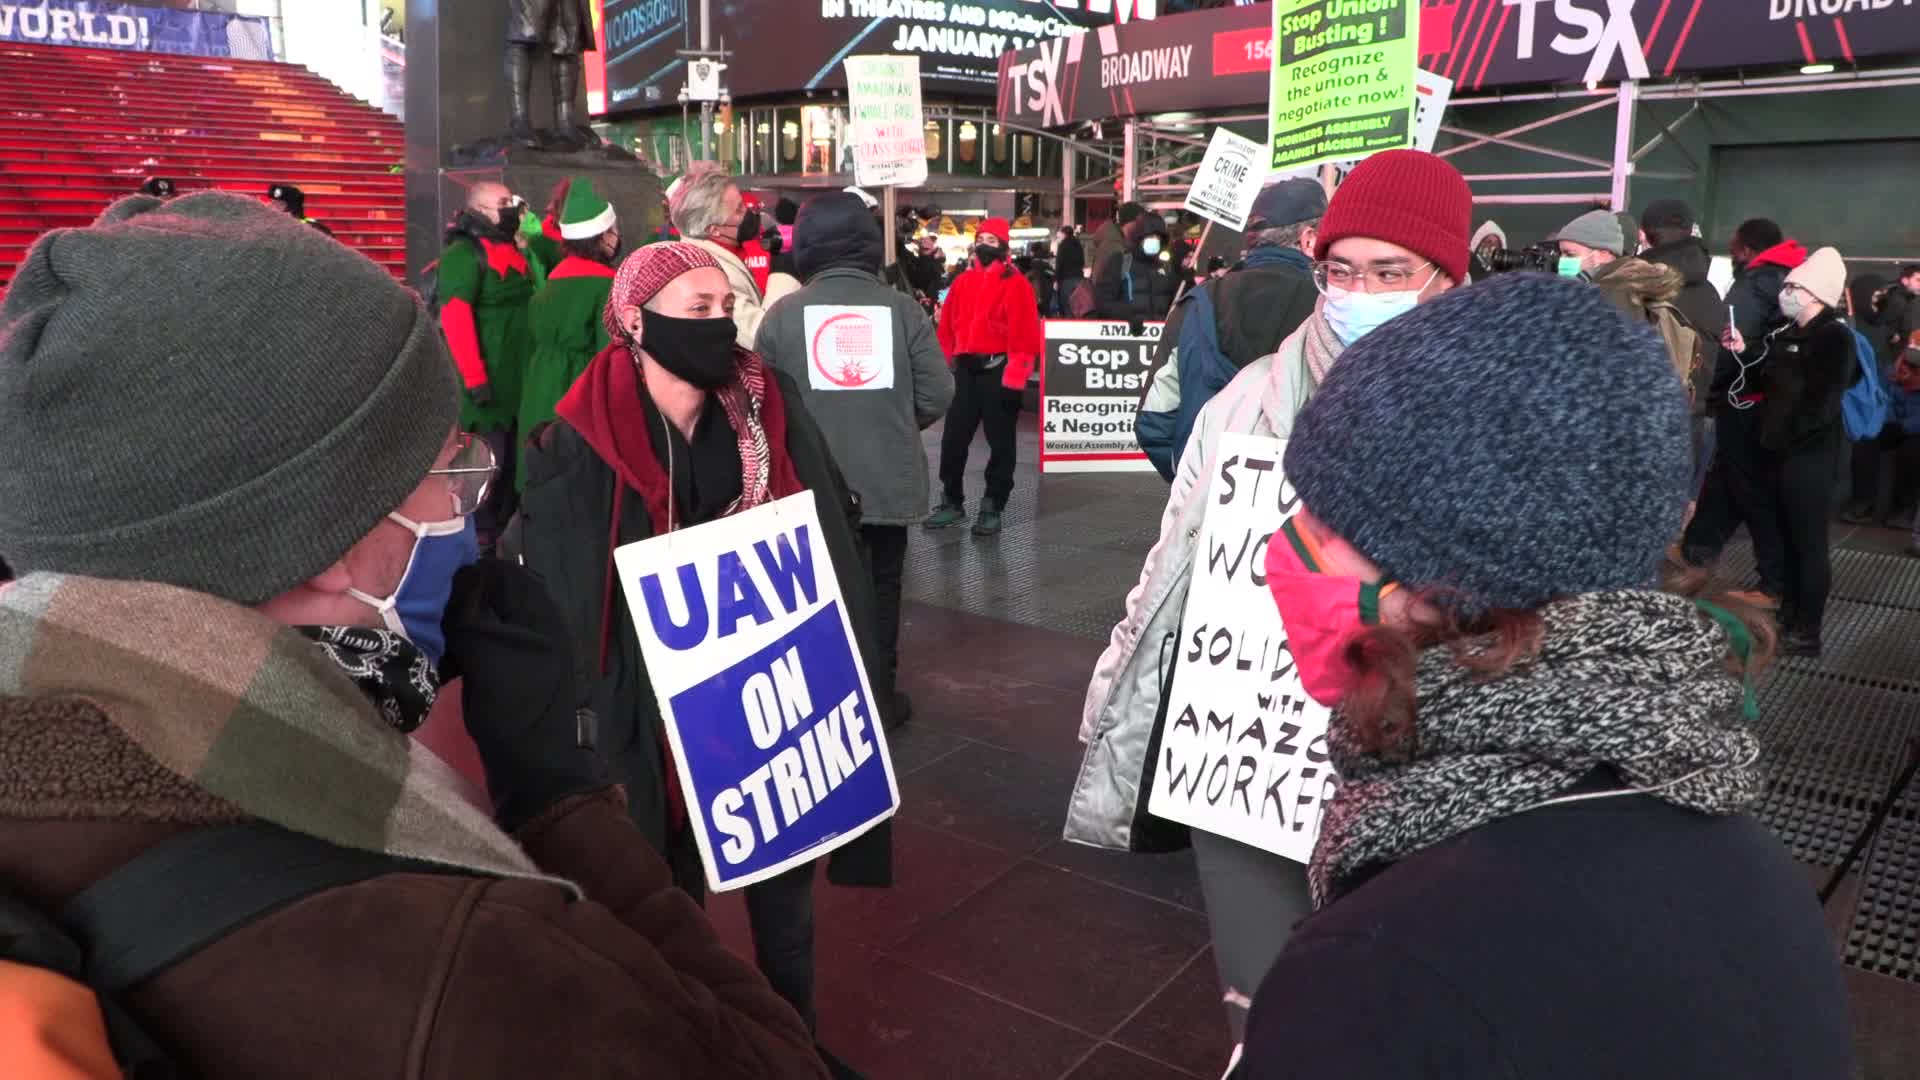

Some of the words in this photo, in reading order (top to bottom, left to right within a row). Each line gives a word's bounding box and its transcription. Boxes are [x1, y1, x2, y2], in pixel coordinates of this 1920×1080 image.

[821, 0, 845, 17] IN
[850, 0, 947, 21] THEATRES
[949, 4, 986, 26] AND
[1283, 9, 1322, 35] Stop
[1327, 0, 1398, 19] Union
[892, 24, 1005, 58] JANUARY
[1293, 21, 1374, 55] Busting
[1496, 0, 1651, 81] TSX
[1008, 37, 1065, 128] TSX
[1101, 45, 1193, 88] BROADWAY
[1291, 51, 1385, 81] Recognize
[1287, 85, 1311, 102] the
[1315, 74, 1369, 93] union
[1375, 67, 1388, 82] &
[1278, 94, 1352, 123] negotiate
[1358, 85, 1405, 105] now!
[1276, 127, 1323, 148] WORKERS
[1325, 115, 1391, 135] ASSEMBLY
[1274, 144, 1316, 164] AGAINST
[1317, 136, 1364, 154] RACISM
[1214, 156, 1249, 183] CRIME
[1100, 324, 1162, 338] AMZO
[1058, 343, 1130, 370] Stop
[1139, 344, 1158, 366] U
[1085, 368, 1149, 390] Bust
[1047, 399, 1138, 416] Recogniz
[1044, 420, 1057, 433] &
[1062, 418, 1138, 437] Negoti
[1045, 441, 1083, 450] Workers
[1085, 441, 1125, 451] Assembly
[1219, 454, 1300, 515] STO
[1209, 527, 1274, 587] WO
[639, 524, 819, 651] UAW
[1187, 623, 1298, 682] SOLID
[741, 645, 813, 751] ON
[1257, 692, 1306, 717] WITH
[1173, 703, 1329, 764] AMAZO
[710, 689, 873, 865] STRIKE
[1166, 747, 1338, 838] WORKER
